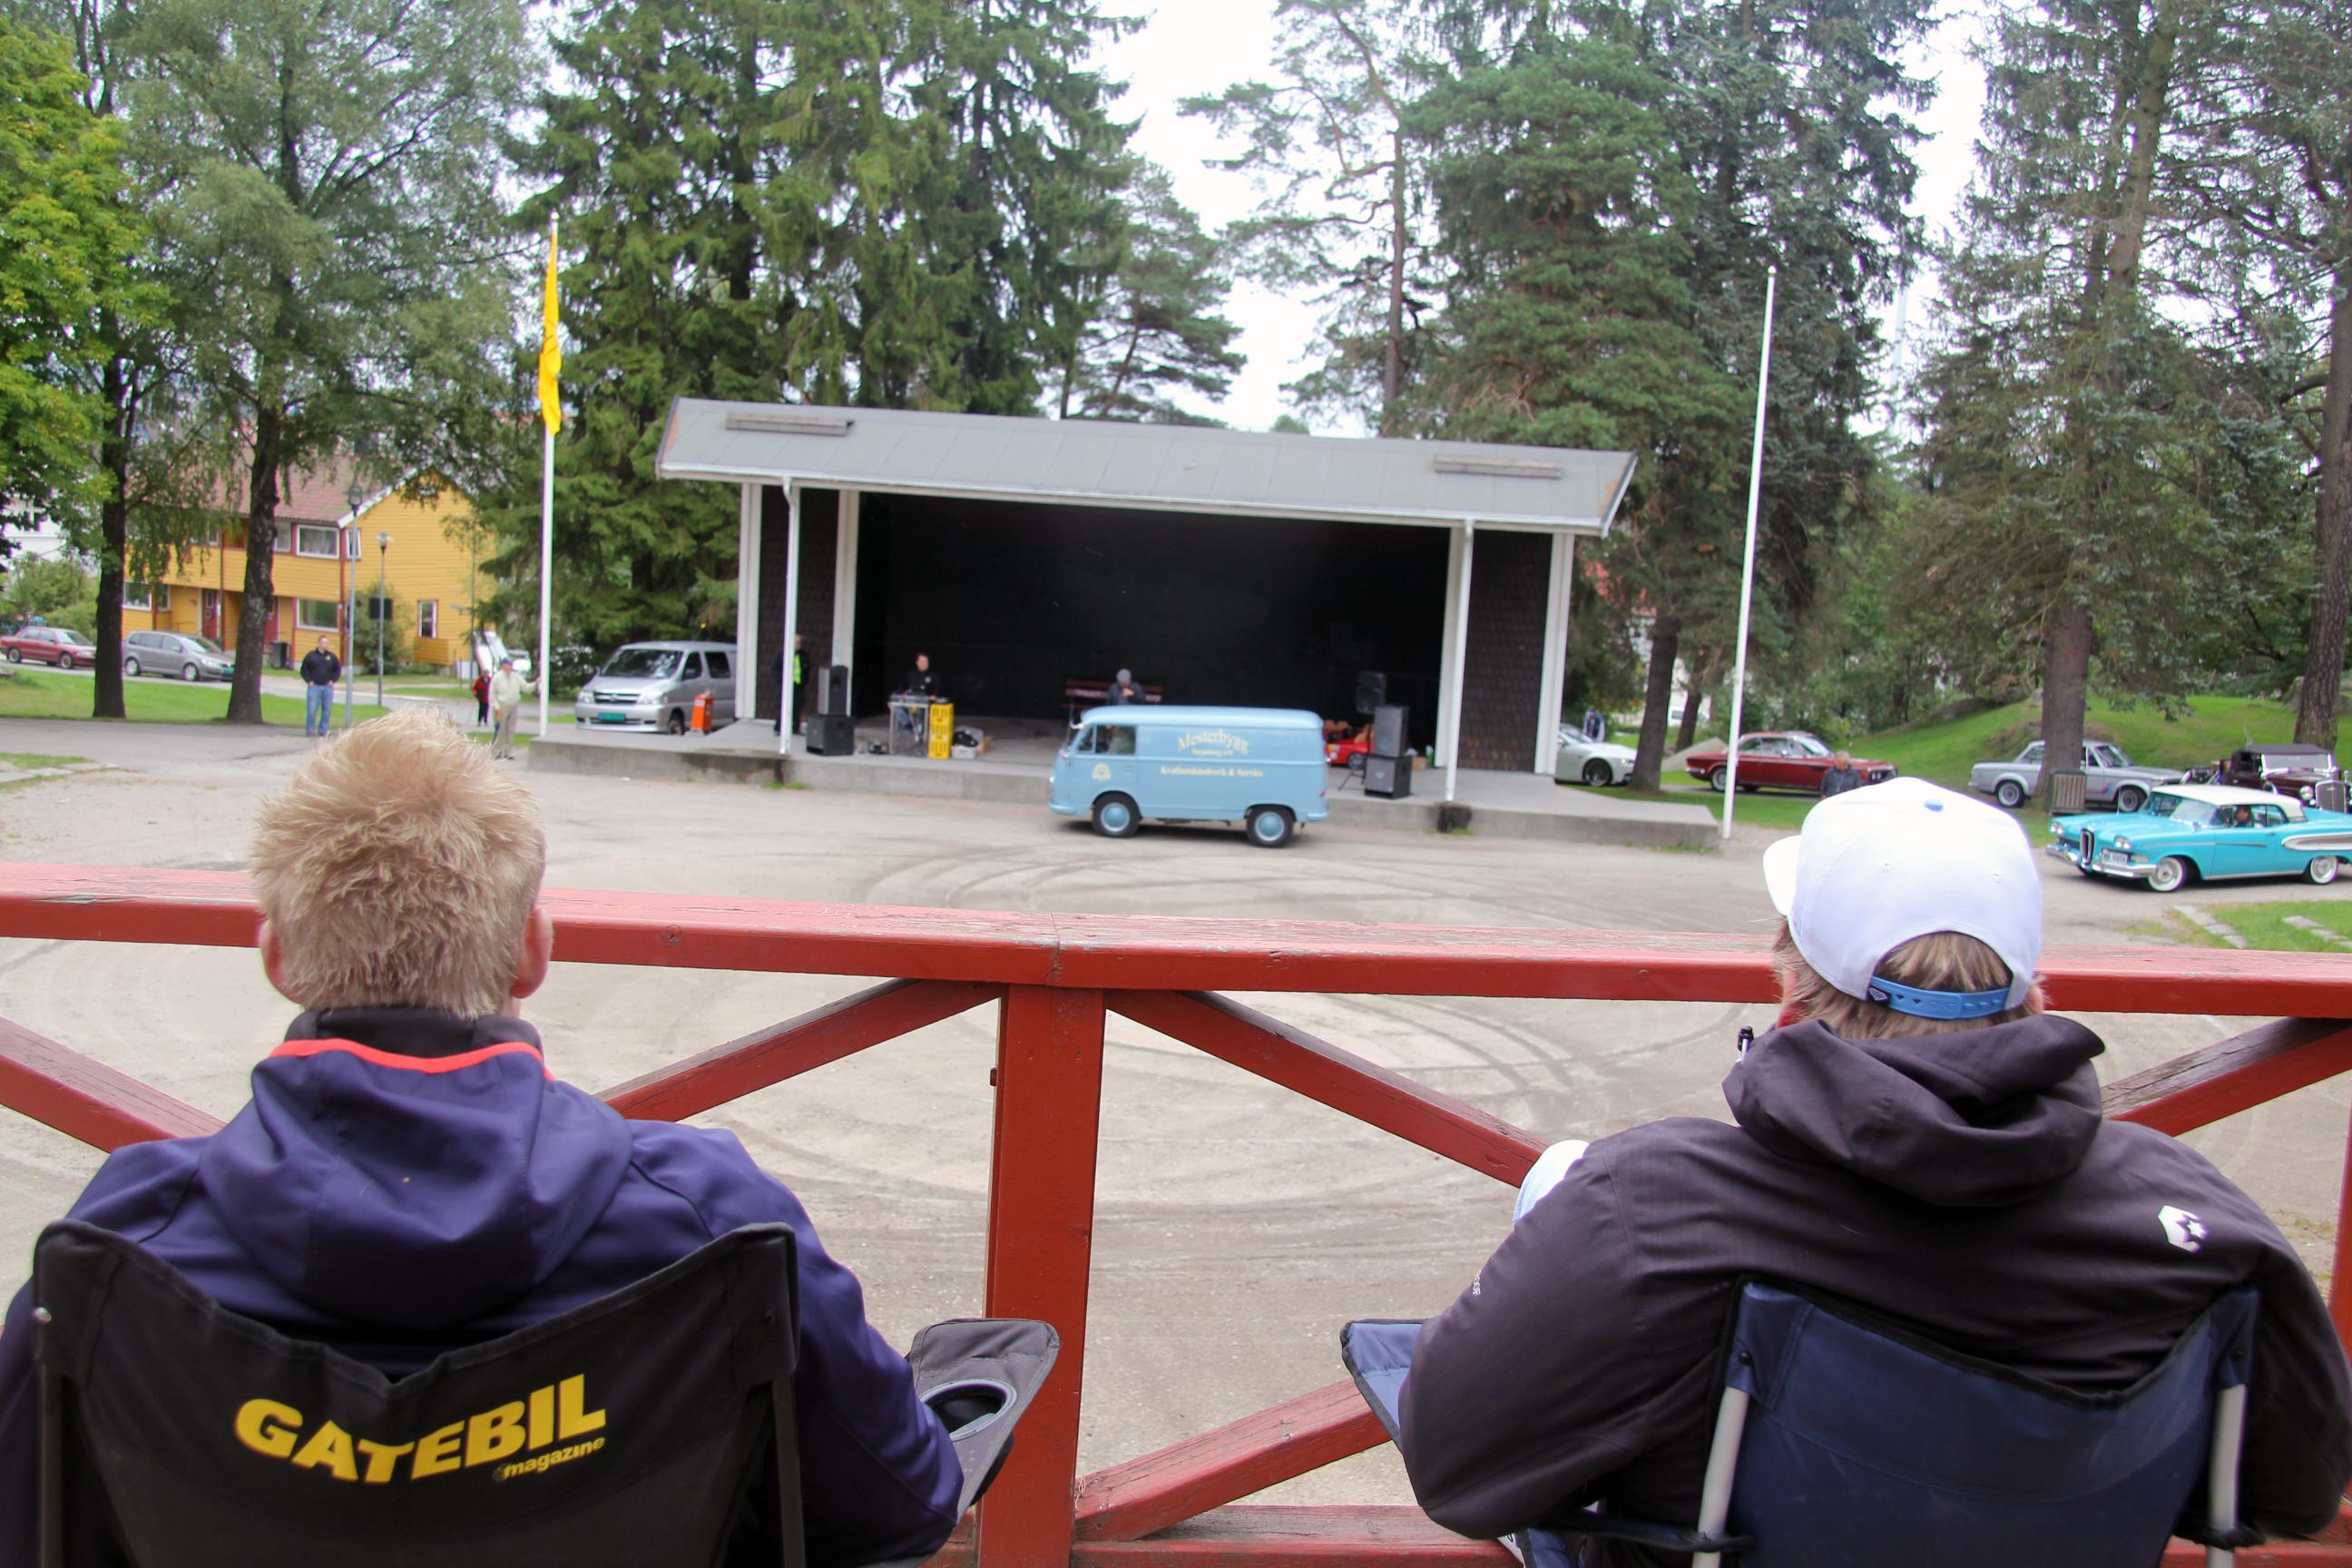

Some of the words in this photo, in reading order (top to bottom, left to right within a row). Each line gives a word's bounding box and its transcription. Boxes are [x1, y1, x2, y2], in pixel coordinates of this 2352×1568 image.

[1178, 728, 1249, 756] Mesterbygg
[234, 1373, 607, 1484] GATEBIL
[503, 1436, 606, 1481] magazine
